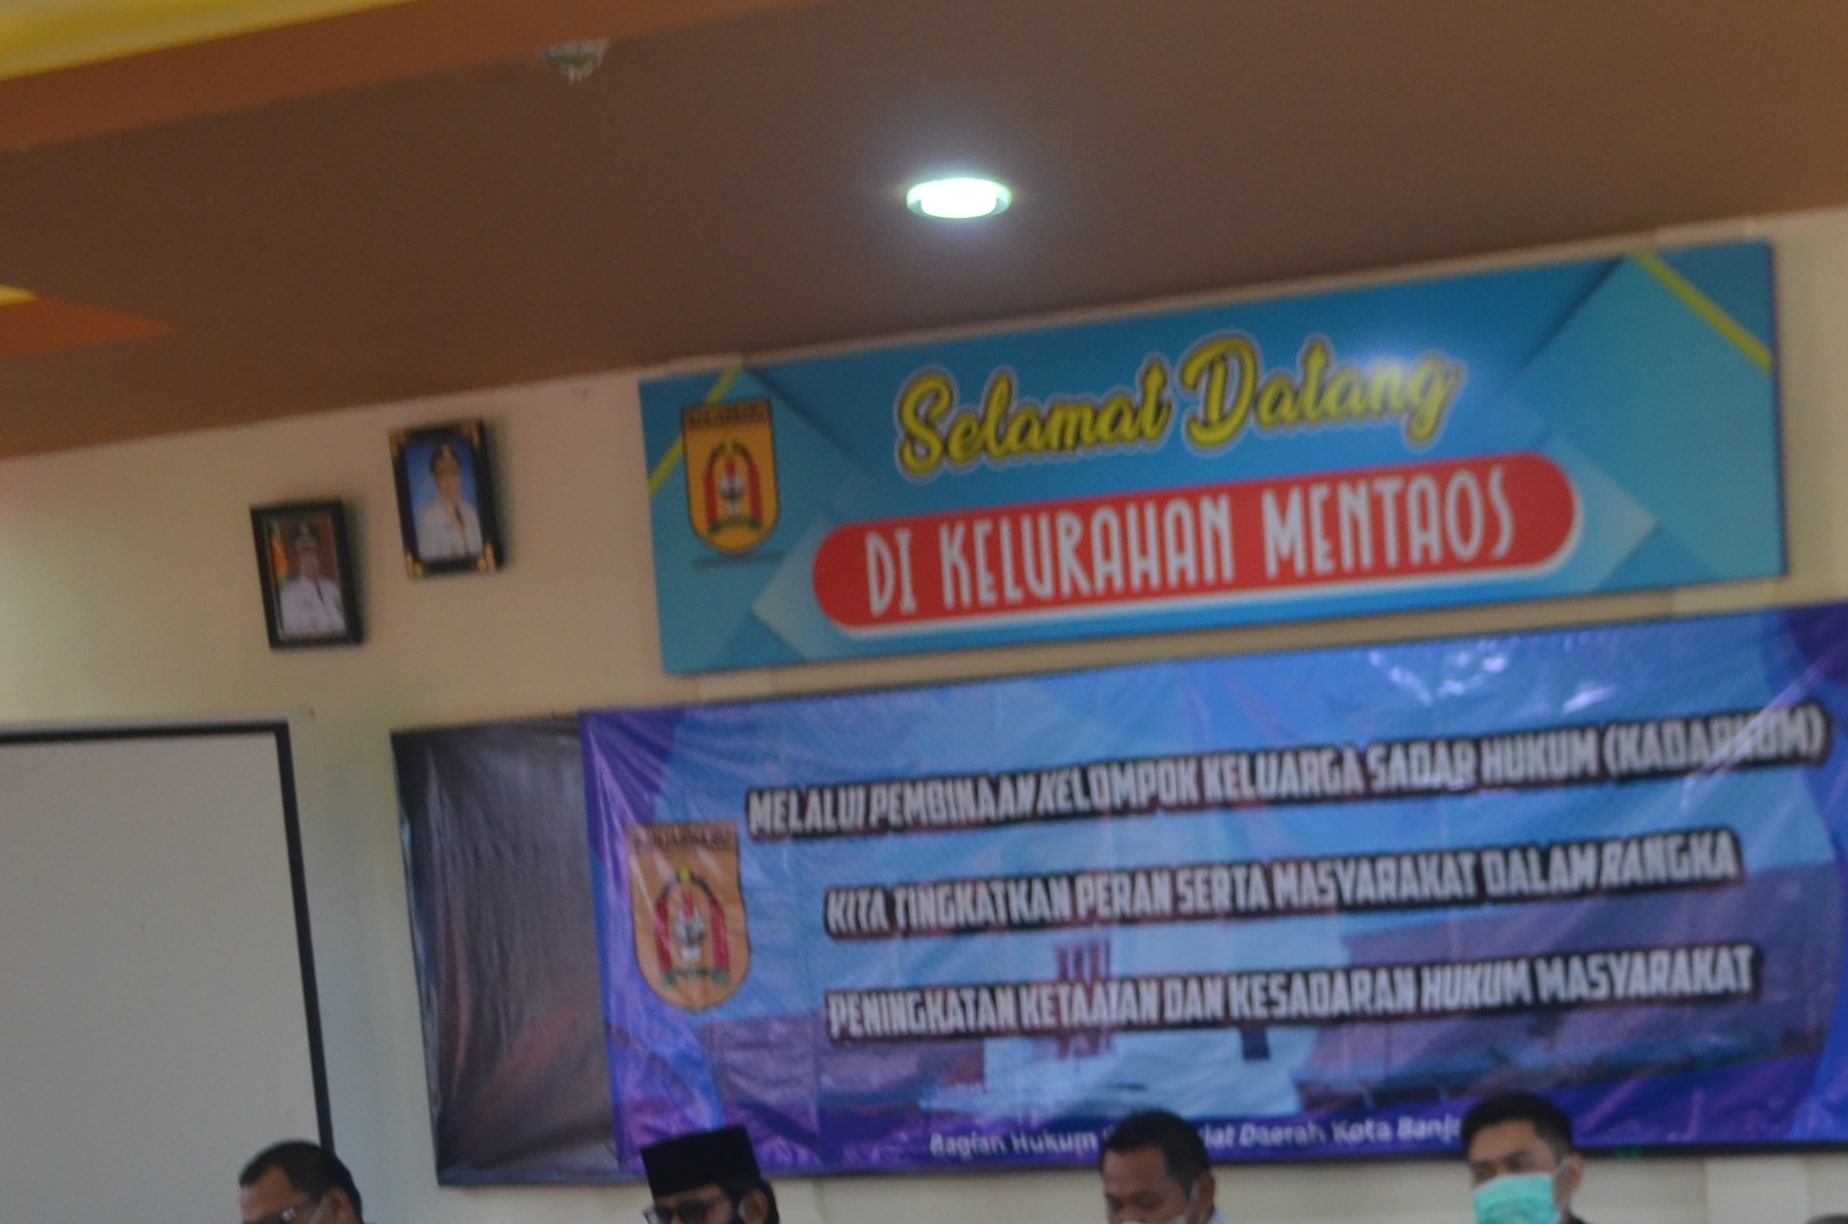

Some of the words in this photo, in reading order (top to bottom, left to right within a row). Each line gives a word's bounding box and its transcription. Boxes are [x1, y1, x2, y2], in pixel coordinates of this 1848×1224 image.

[896, 360, 1174, 477] Selamat
[1178, 335, 1461, 447] Datang
[865, 528, 916, 617] DI
[940, 493, 1235, 611] KELURAHAN
[1262, 467, 1515, 578] MENTAOS
[748, 784, 867, 838] MELALUI
[868, 771, 1037, 829] PEMBINAAN
[1036, 756, 1202, 816] KELOMPOK
[1203, 748, 1365, 803] KELUARGA
[1368, 738, 1477, 792] SADAR
[1481, 727, 1600, 785] HUKUM
[826, 887, 893, 936] KITA
[894, 874, 1073, 931] TINGKATKAN
[1075, 867, 1174, 920] PERAN
[1177, 862, 1270, 915] SERTA
[1272, 852, 1478, 910] MASYARAKAT
[1481, 842, 1600, 897] DALAM
[1600, 829, 1741, 888] RANGKA
[827, 985, 1018, 1040] PENINGKATAN
[1020, 979, 1161, 1033] KETAATAN
[1163, 975, 1226, 1026] DAN
[1228, 966, 1419, 1023] KESADARAN
[1420, 959, 1534, 1012] HUKUM
[1536, 944, 1759, 1003] MASYARAKAT
[1010, 1129, 1100, 1154] Hukum
[1239, 1120, 1327, 1147] Daerah
[1332, 1116, 1392, 1145] Kota
